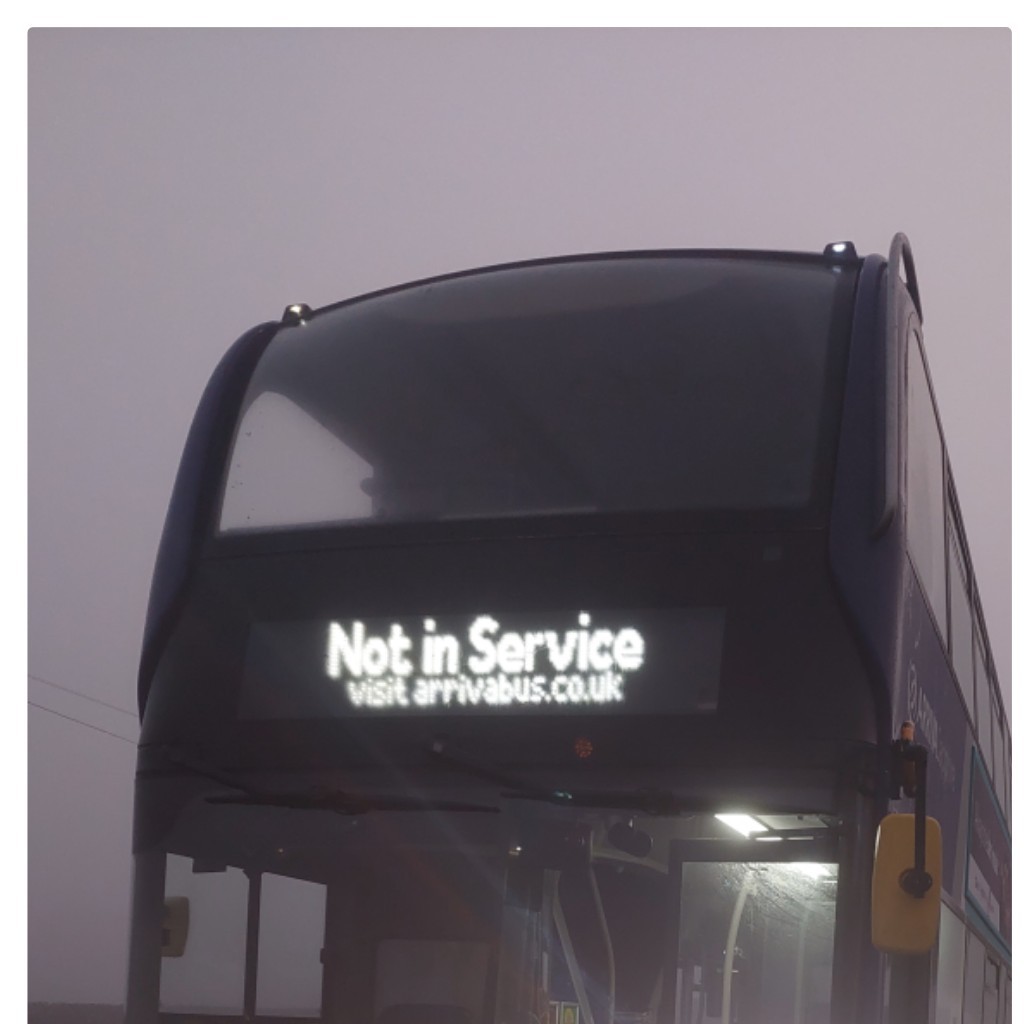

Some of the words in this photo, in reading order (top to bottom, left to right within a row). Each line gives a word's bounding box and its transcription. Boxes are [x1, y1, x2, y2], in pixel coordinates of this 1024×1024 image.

[326, 620, 413, 677] Not
[422, 618, 459, 675] in
[468, 611, 645, 673] Service
[347, 676, 409, 707] visit
[413, 670, 623, 706] arrivabus.co.uk
